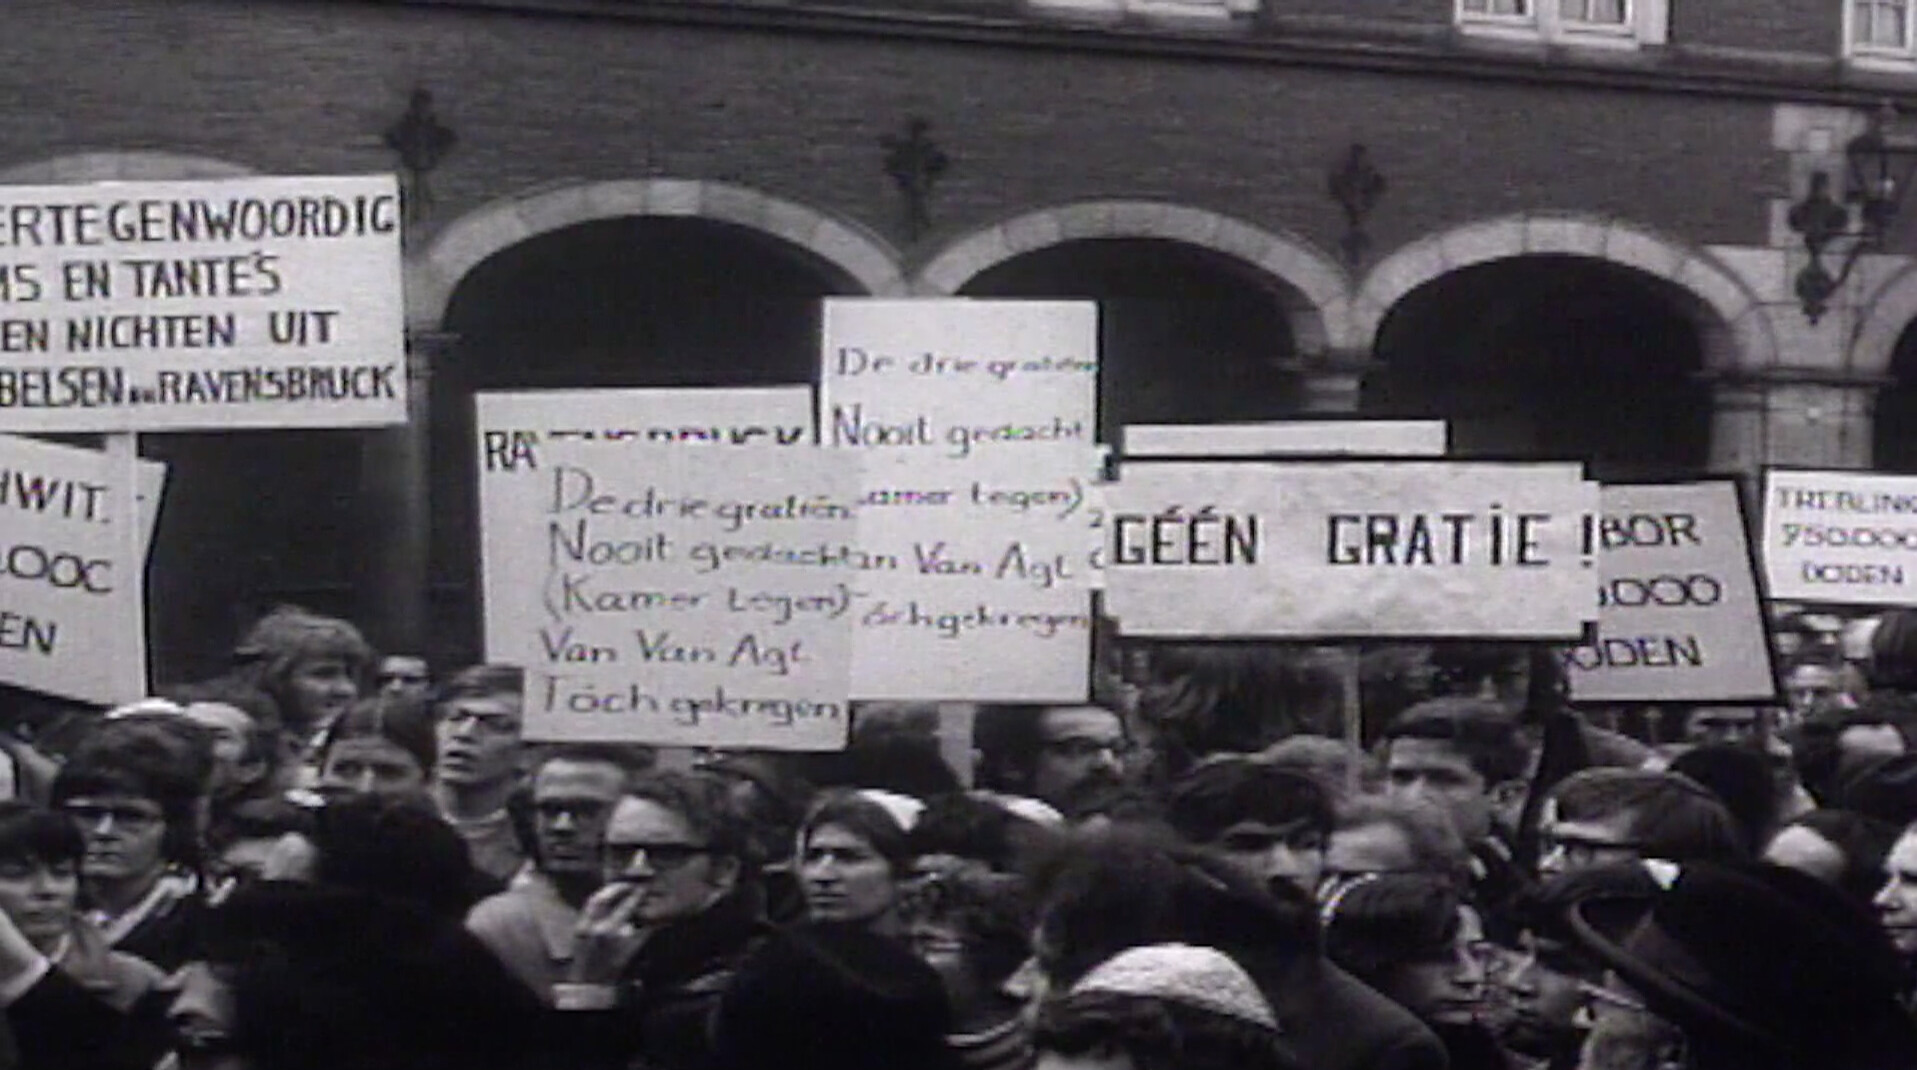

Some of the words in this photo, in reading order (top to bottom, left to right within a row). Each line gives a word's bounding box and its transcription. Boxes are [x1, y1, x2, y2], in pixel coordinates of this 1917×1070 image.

[0, 195, 395, 246] RTEGENWOORDIG
[63, 260, 110, 301] EN
[67, 313, 235, 352] NICHTEN
[269, 311, 340, 347] UIT
[833, 402, 933, 446] Nooit
[858, 489, 953, 506] amer
[548, 516, 674, 573] Nooit
[1112, 504, 1261, 567] GÉÉN
[539, 625, 620, 664] Van
[634, 627, 717, 664] Van
[1564, 634, 1702, 671] ODEN
